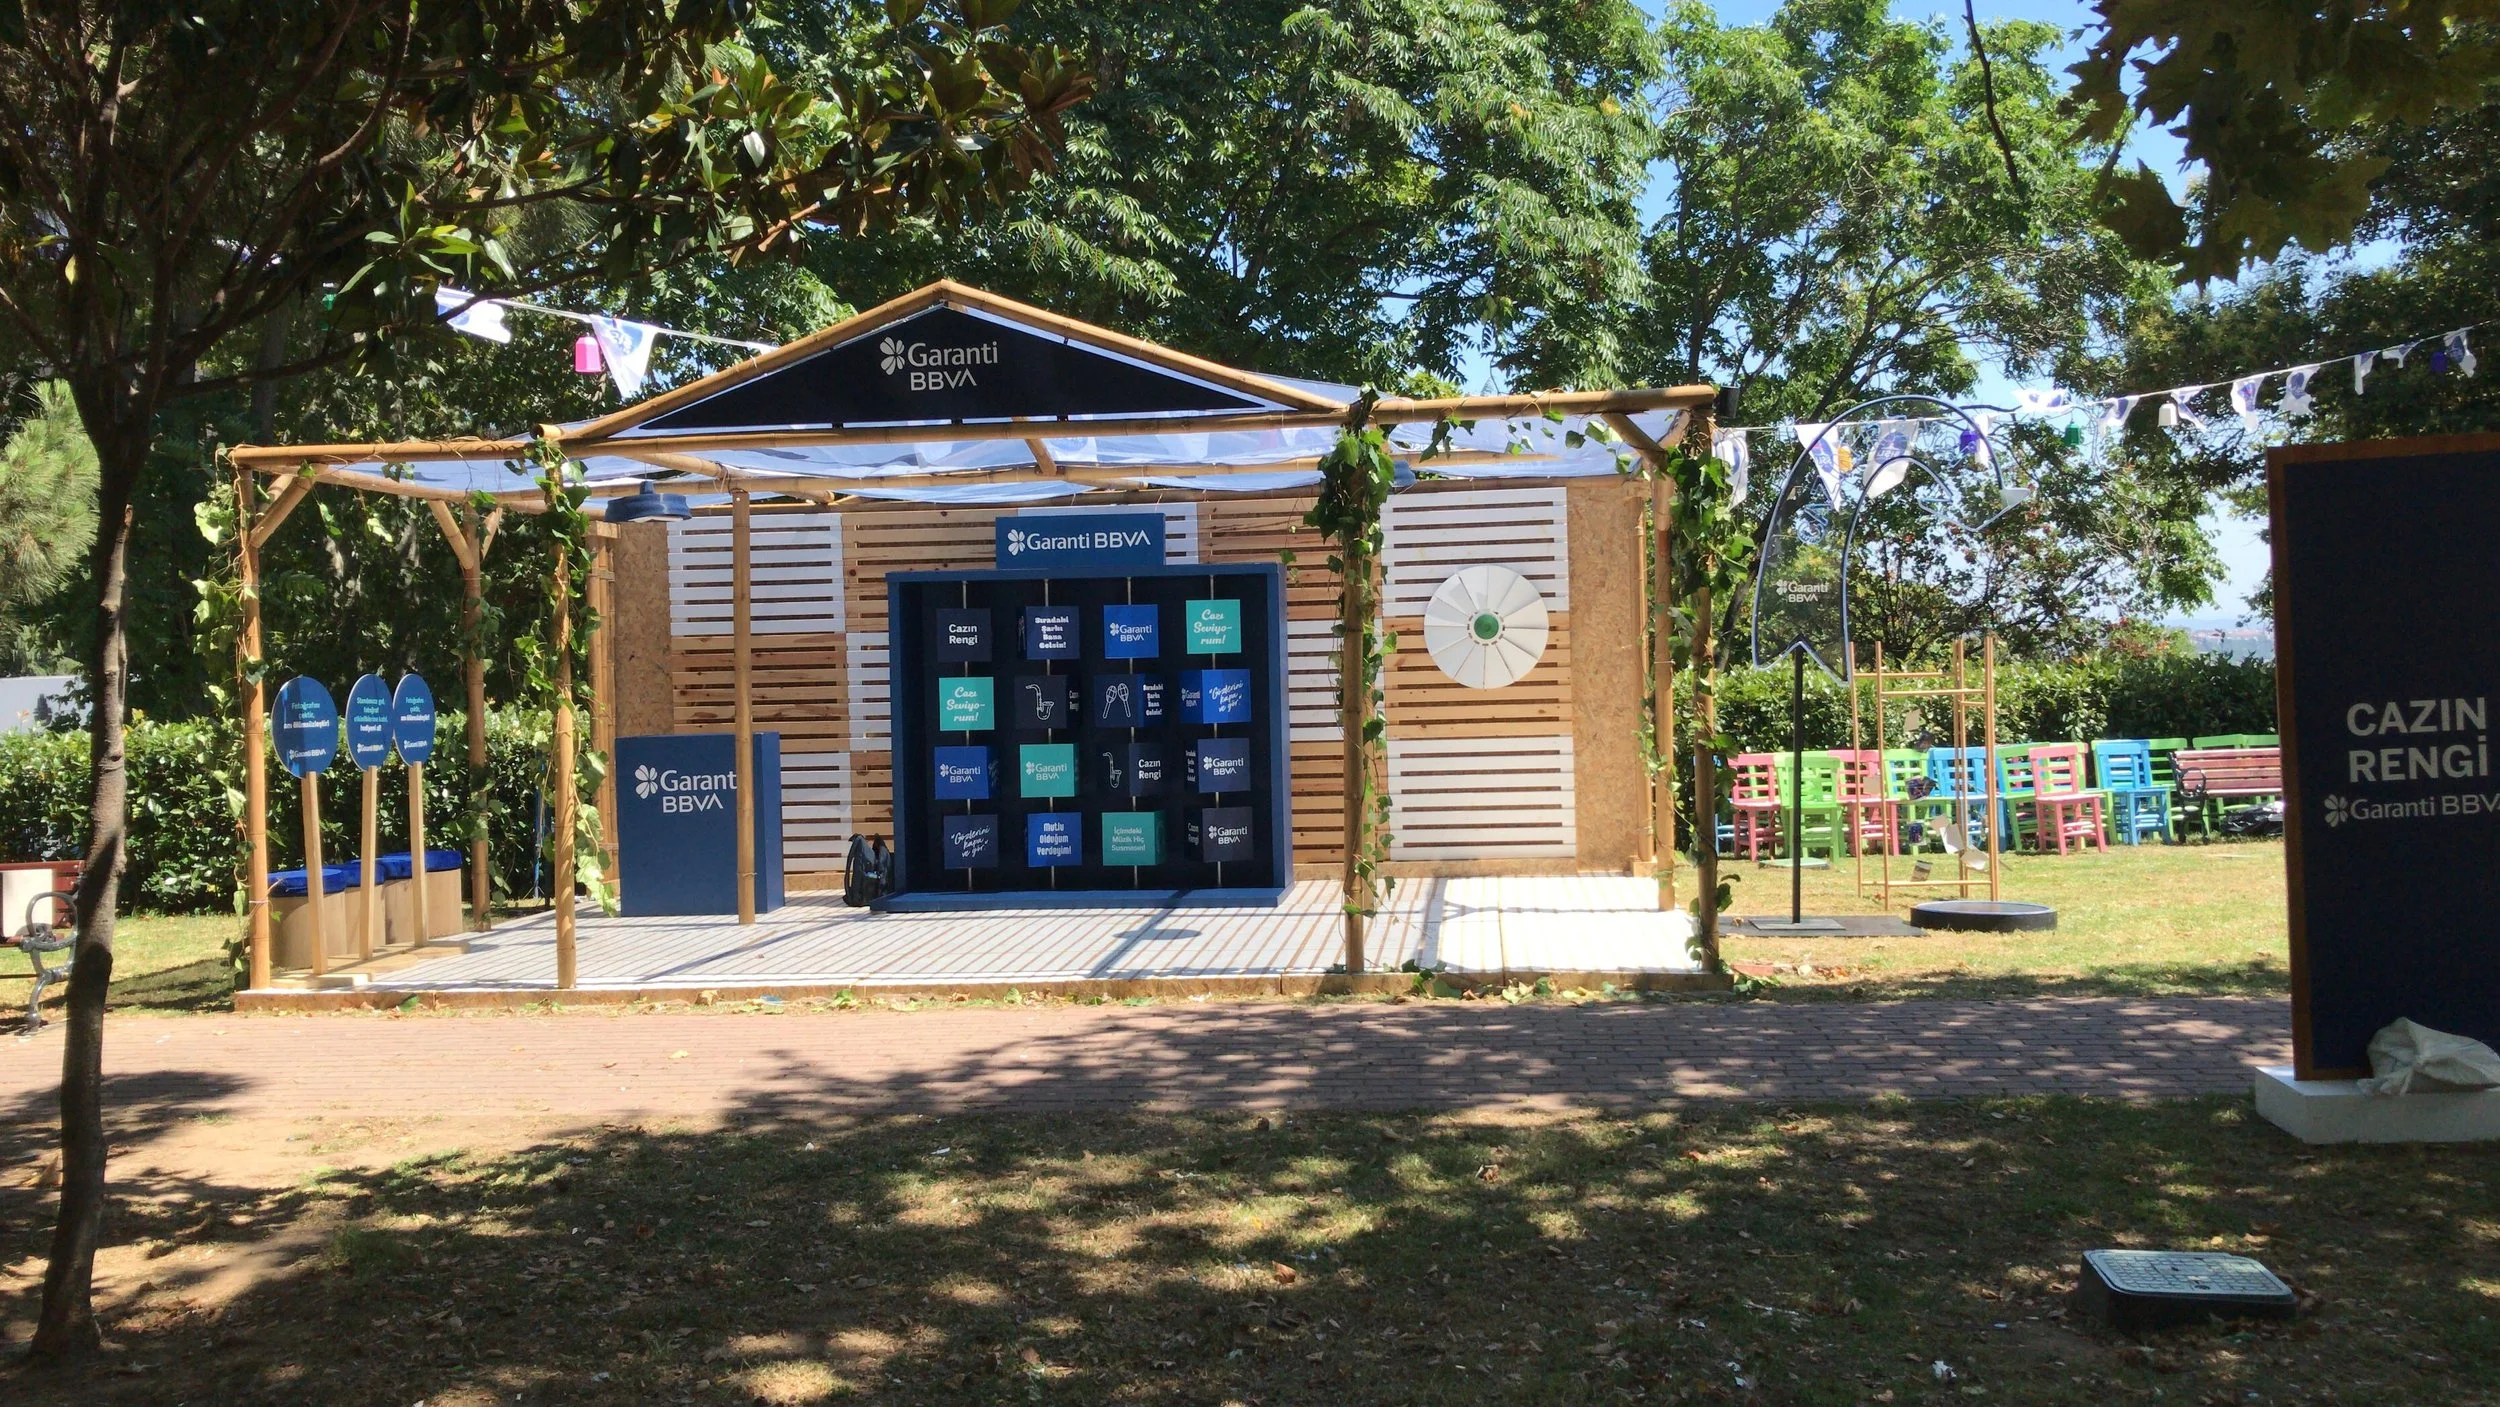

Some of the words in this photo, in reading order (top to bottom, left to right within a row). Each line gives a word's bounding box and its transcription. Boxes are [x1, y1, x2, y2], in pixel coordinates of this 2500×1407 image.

[907, 341, 998, 367] Garanti
[910, 368, 977, 391] BBVA
[1026, 533, 1090, 550] Garanti
[1094, 529, 1151, 548] BBVA
[1788, 582, 1828, 593] Garanti
[1788, 594, 1818, 602] BBVA
[1201, 609, 1225, 620] Cazı
[948, 624, 978, 633] Cazın
[1119, 624, 1152, 634] Garanti
[1193, 621, 1232, 635] Seviyo-
[948, 635, 978, 645] Rengi
[1120, 634, 1144, 642] BBVA
[1200, 635, 1226, 645] rum!
[954, 687, 978, 698] Cazı
[946, 699, 985, 712] Seviyo-
[953, 712, 979, 722] rum!
[2346, 697, 2487, 736] CAZIN
[1138, 758, 1161, 768] Cazın
[1212, 757, 1244, 767] Garanti
[2348, 735, 2489, 783] RENGİ
[949, 765, 981, 775] Garanti
[1035, 763, 1067, 772] Garanti
[1213, 767, 1237, 776] BBVA
[1036, 773, 1060, 781] BBVA
[1138, 770, 1161, 780] Rengi
[660, 769, 738, 792] Garant
[662, 792, 724, 813] BBVA
[2350, 796, 2435, 820] Garanti
[2441, 793, 2500, 815] BBV
[1217, 826, 1248, 836] Garanti
[1218, 836, 1241, 845] BBVA
